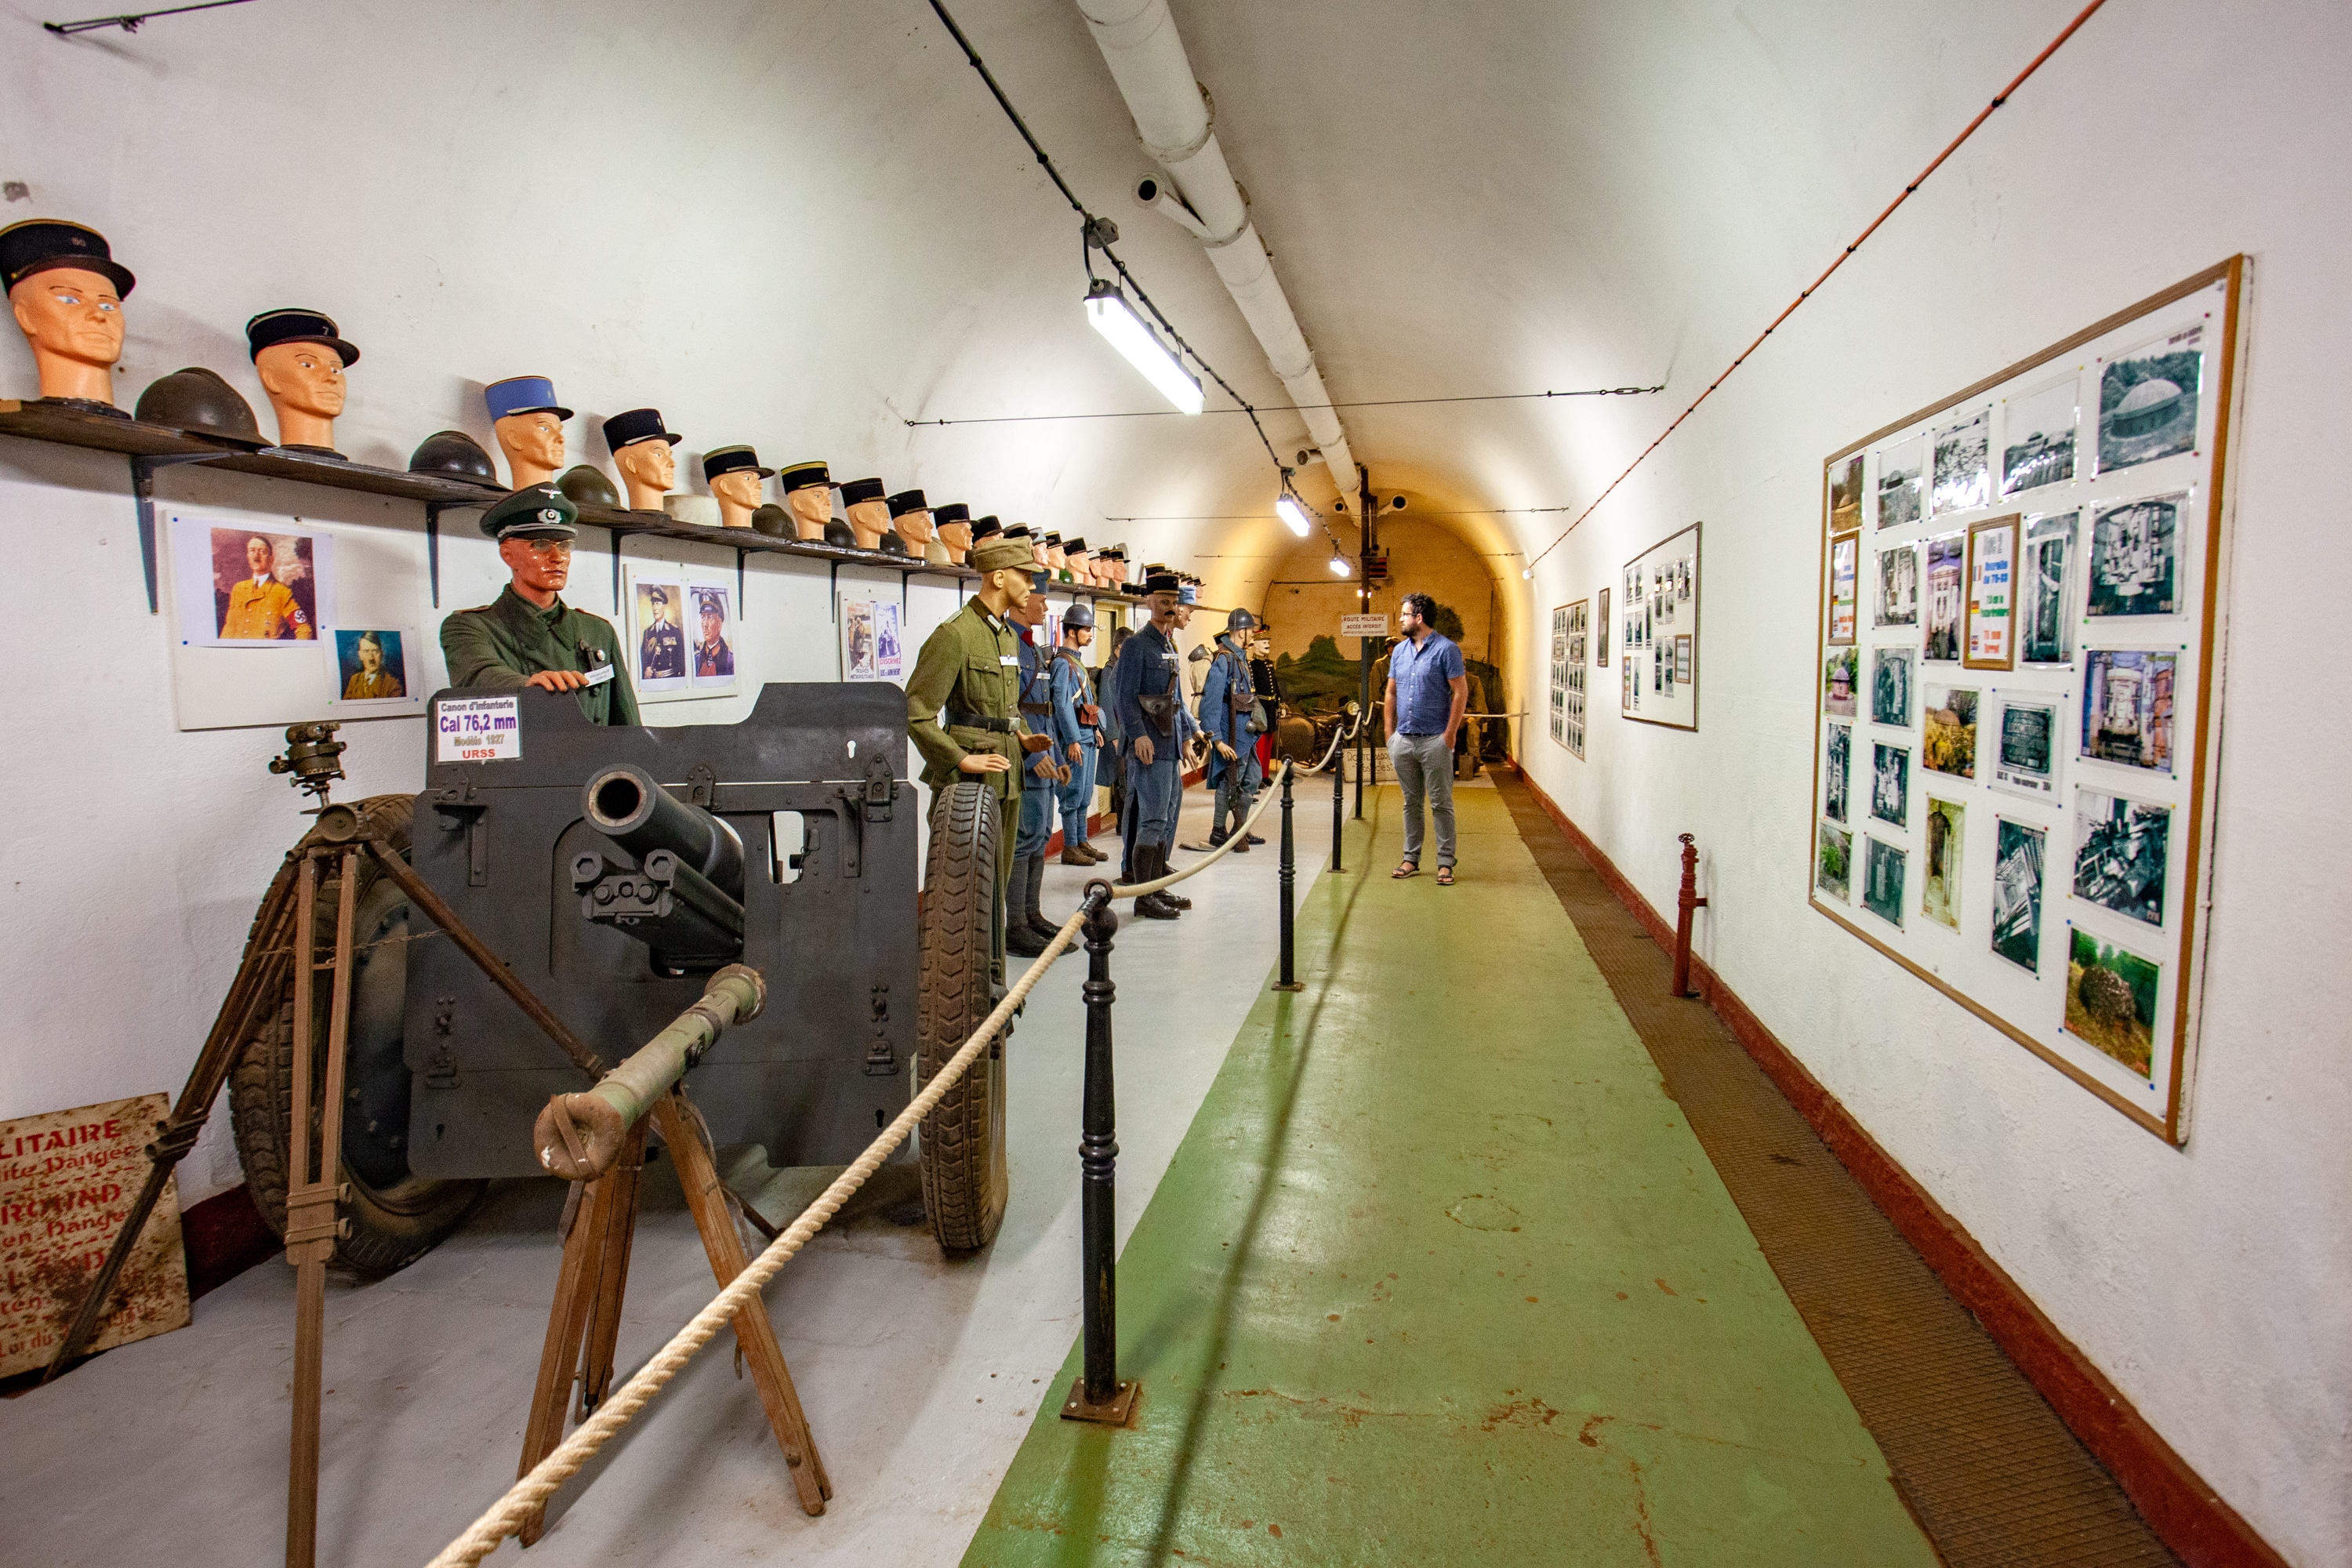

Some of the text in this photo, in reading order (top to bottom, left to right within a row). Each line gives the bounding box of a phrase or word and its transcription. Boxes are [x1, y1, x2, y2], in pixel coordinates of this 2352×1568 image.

[441, 699, 514, 712] Canon d'infanterie
[440, 713, 517, 735] Cal 76,2 mm
[485, 734, 505, 745] 1927
[462, 749, 495, 759] URSS
[45, 1145, 136, 1174] Danger
[47, 1210, 127, 1238] Dange
